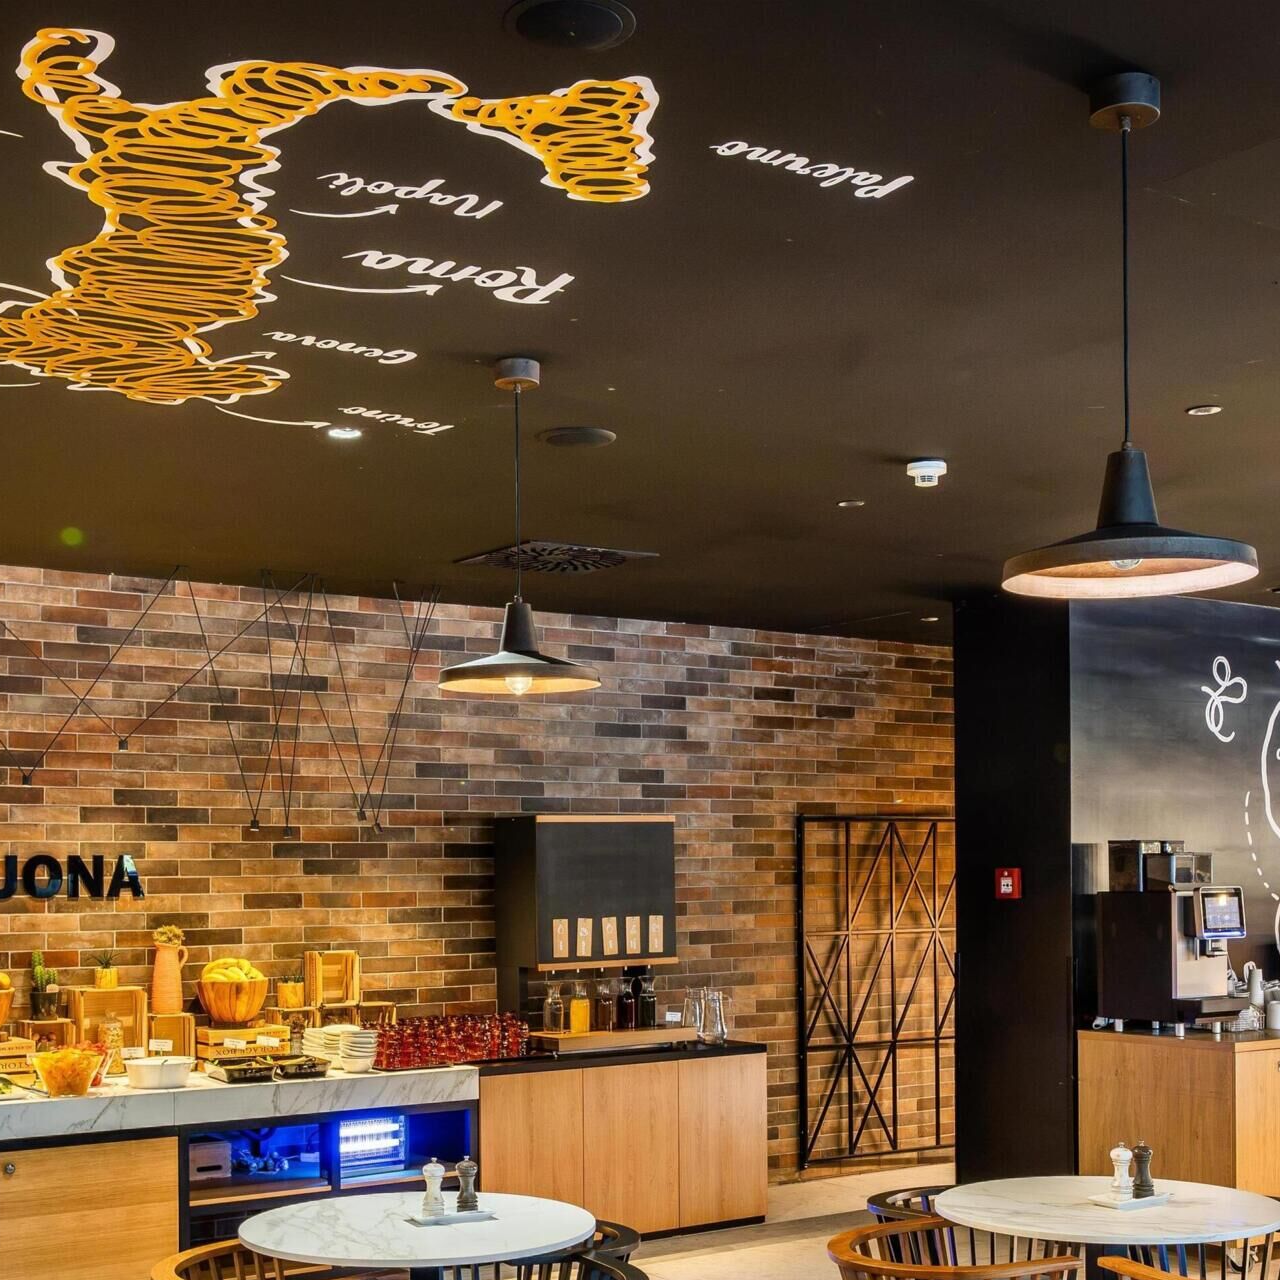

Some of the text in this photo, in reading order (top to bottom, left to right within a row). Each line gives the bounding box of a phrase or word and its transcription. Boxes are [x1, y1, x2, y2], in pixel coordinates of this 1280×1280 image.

[709, 140, 915, 199] Palermo
[316, 172, 504, 219] Napoli
[342, 250, 575, 305] Roma
[261, 331, 418, 365] Genova
[337, 406, 455, 436] Torino
